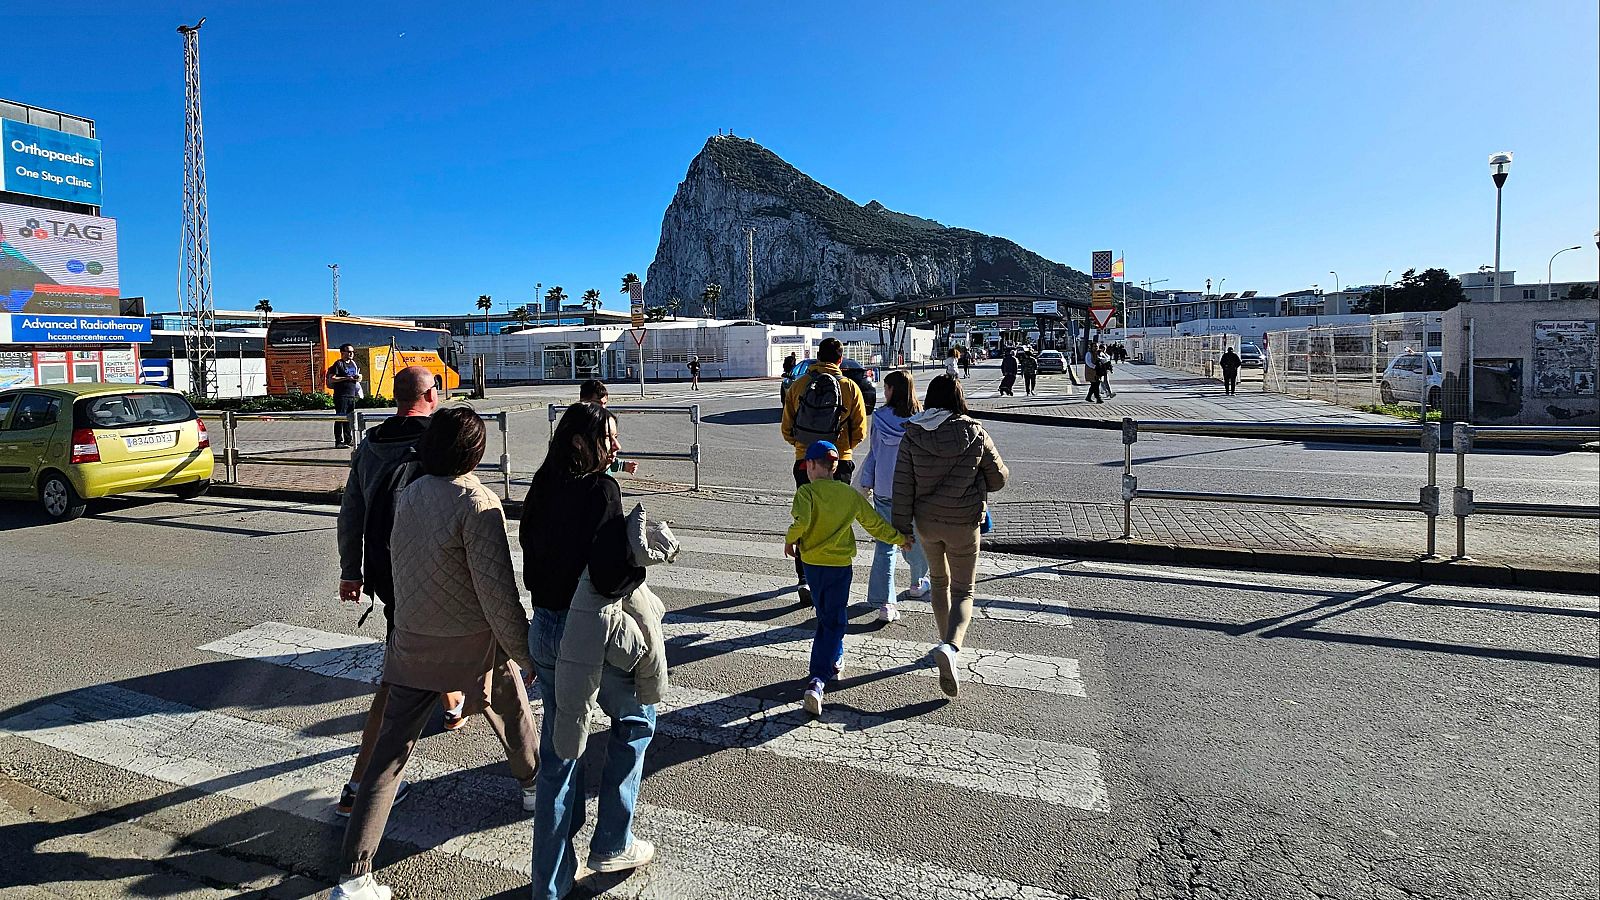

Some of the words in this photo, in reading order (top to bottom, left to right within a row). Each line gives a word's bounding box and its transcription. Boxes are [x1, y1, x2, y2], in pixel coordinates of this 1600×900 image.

[11, 140, 95, 167] Orthopaedics
[16, 166, 39, 179] One
[41, 171, 64, 185] Stop
[65, 176, 93, 189] Clinic
[46, 219, 103, 241] TAG
[22, 318, 77, 330] Advanced
[80, 319, 144, 333] Radiotherapy
[47, 332, 124, 341] hccancercenter.com
[132, 436, 155, 446] 8340
